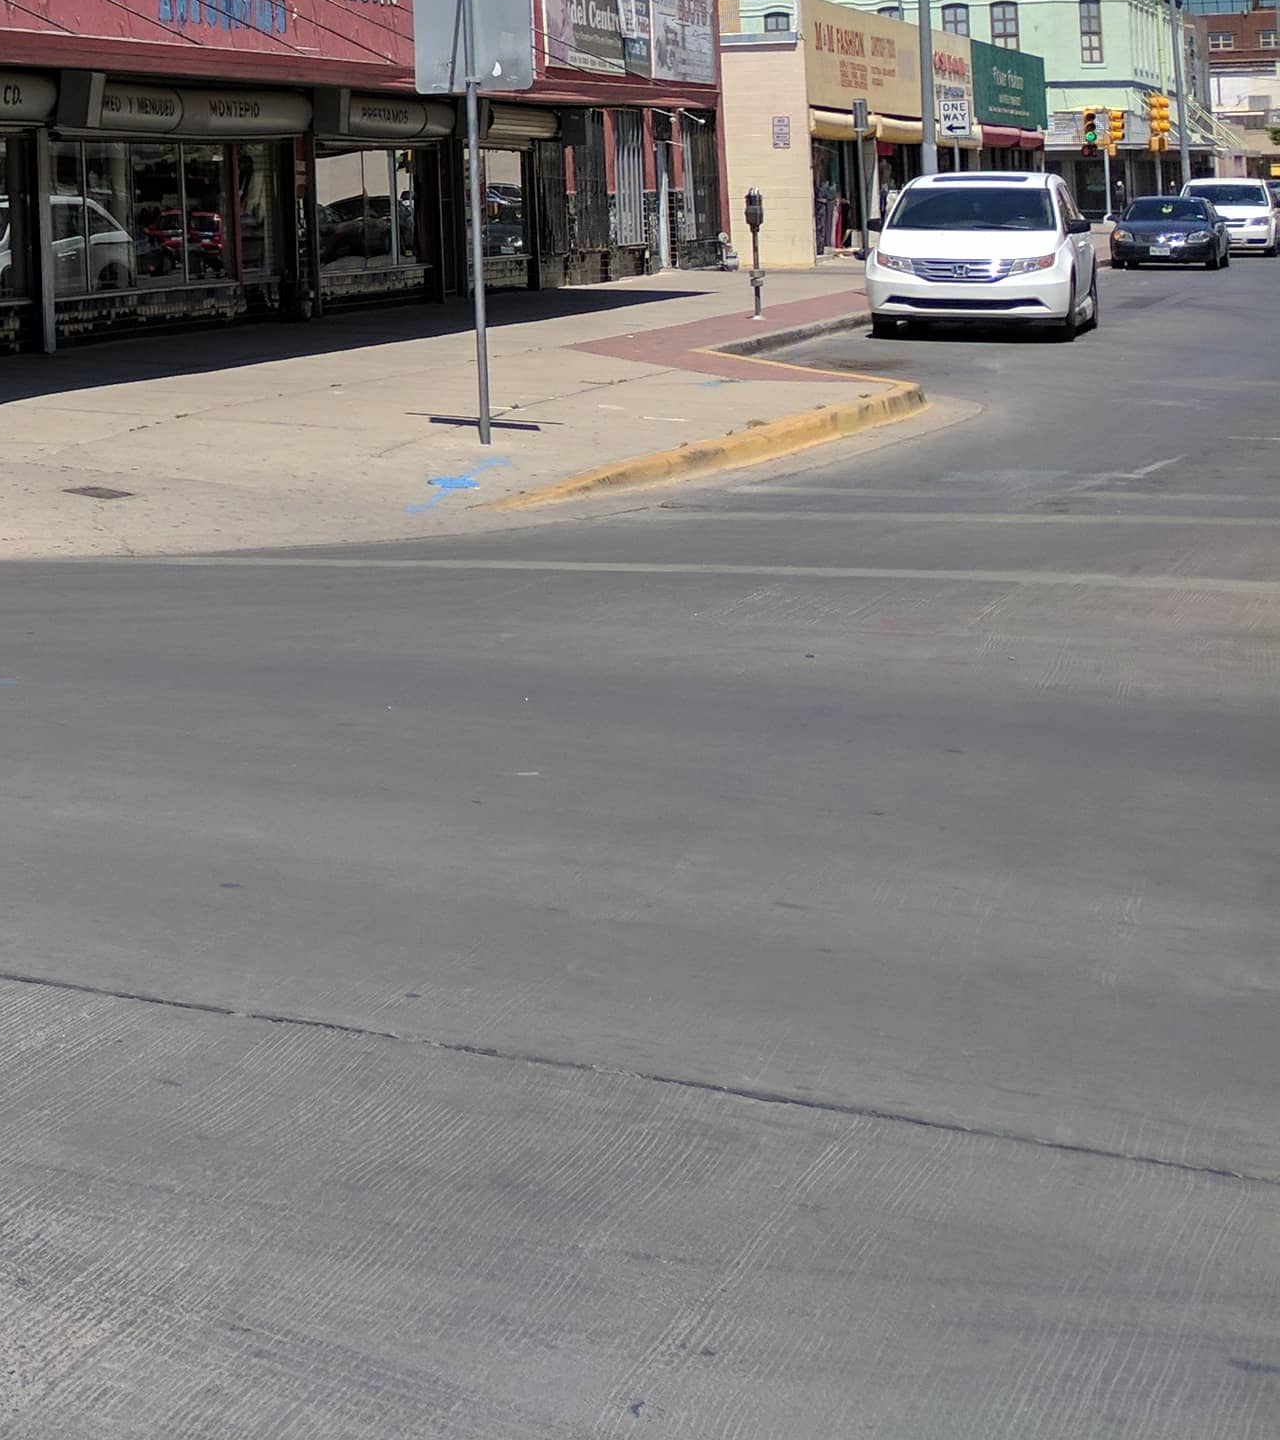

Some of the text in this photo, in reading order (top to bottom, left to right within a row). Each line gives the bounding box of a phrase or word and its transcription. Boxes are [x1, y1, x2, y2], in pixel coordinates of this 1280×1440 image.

[836, 27, 866, 58] FASHION
[3, 85, 24, 105] CO.
[209, 98, 261, 119] MONTEPIO
[942, 102, 967, 112] ONE
[942, 112, 968, 122] WAY
